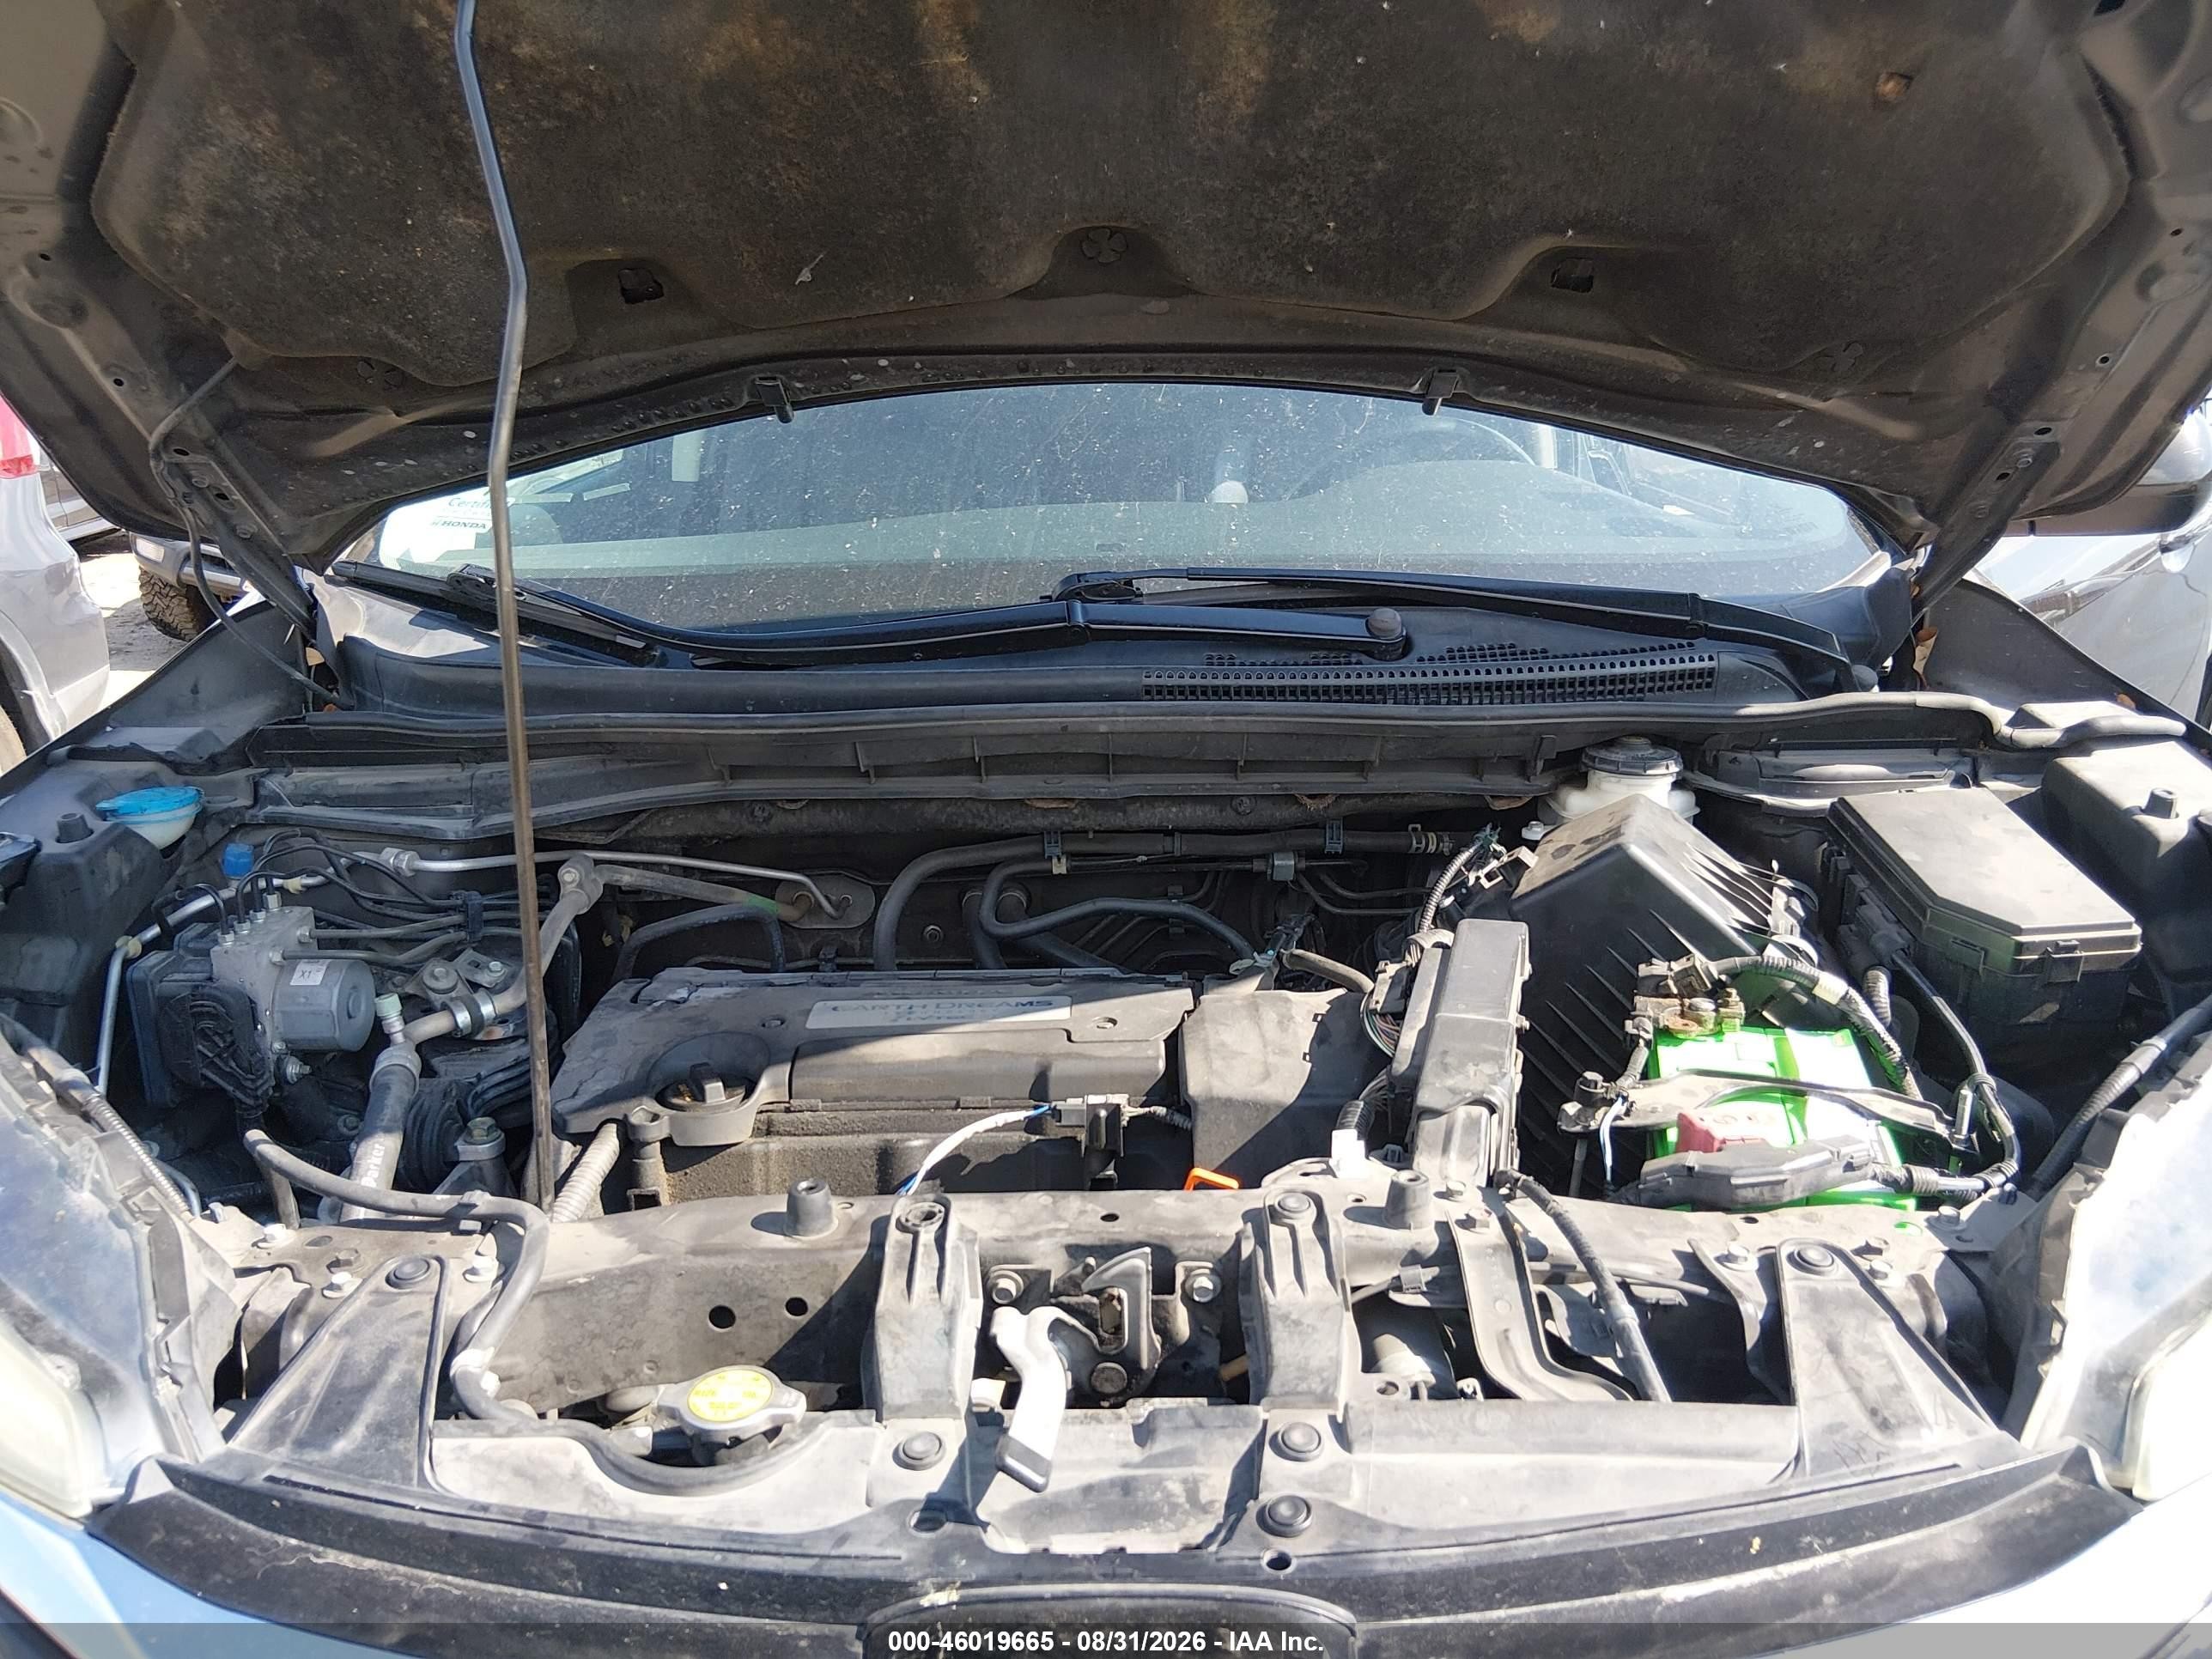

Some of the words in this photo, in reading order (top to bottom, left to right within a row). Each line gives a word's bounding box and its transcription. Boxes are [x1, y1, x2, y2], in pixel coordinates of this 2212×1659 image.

[441, 520, 486, 529] HONDA
[298, 969, 313, 980] X1
[361, 1143, 386, 1188] Parker
